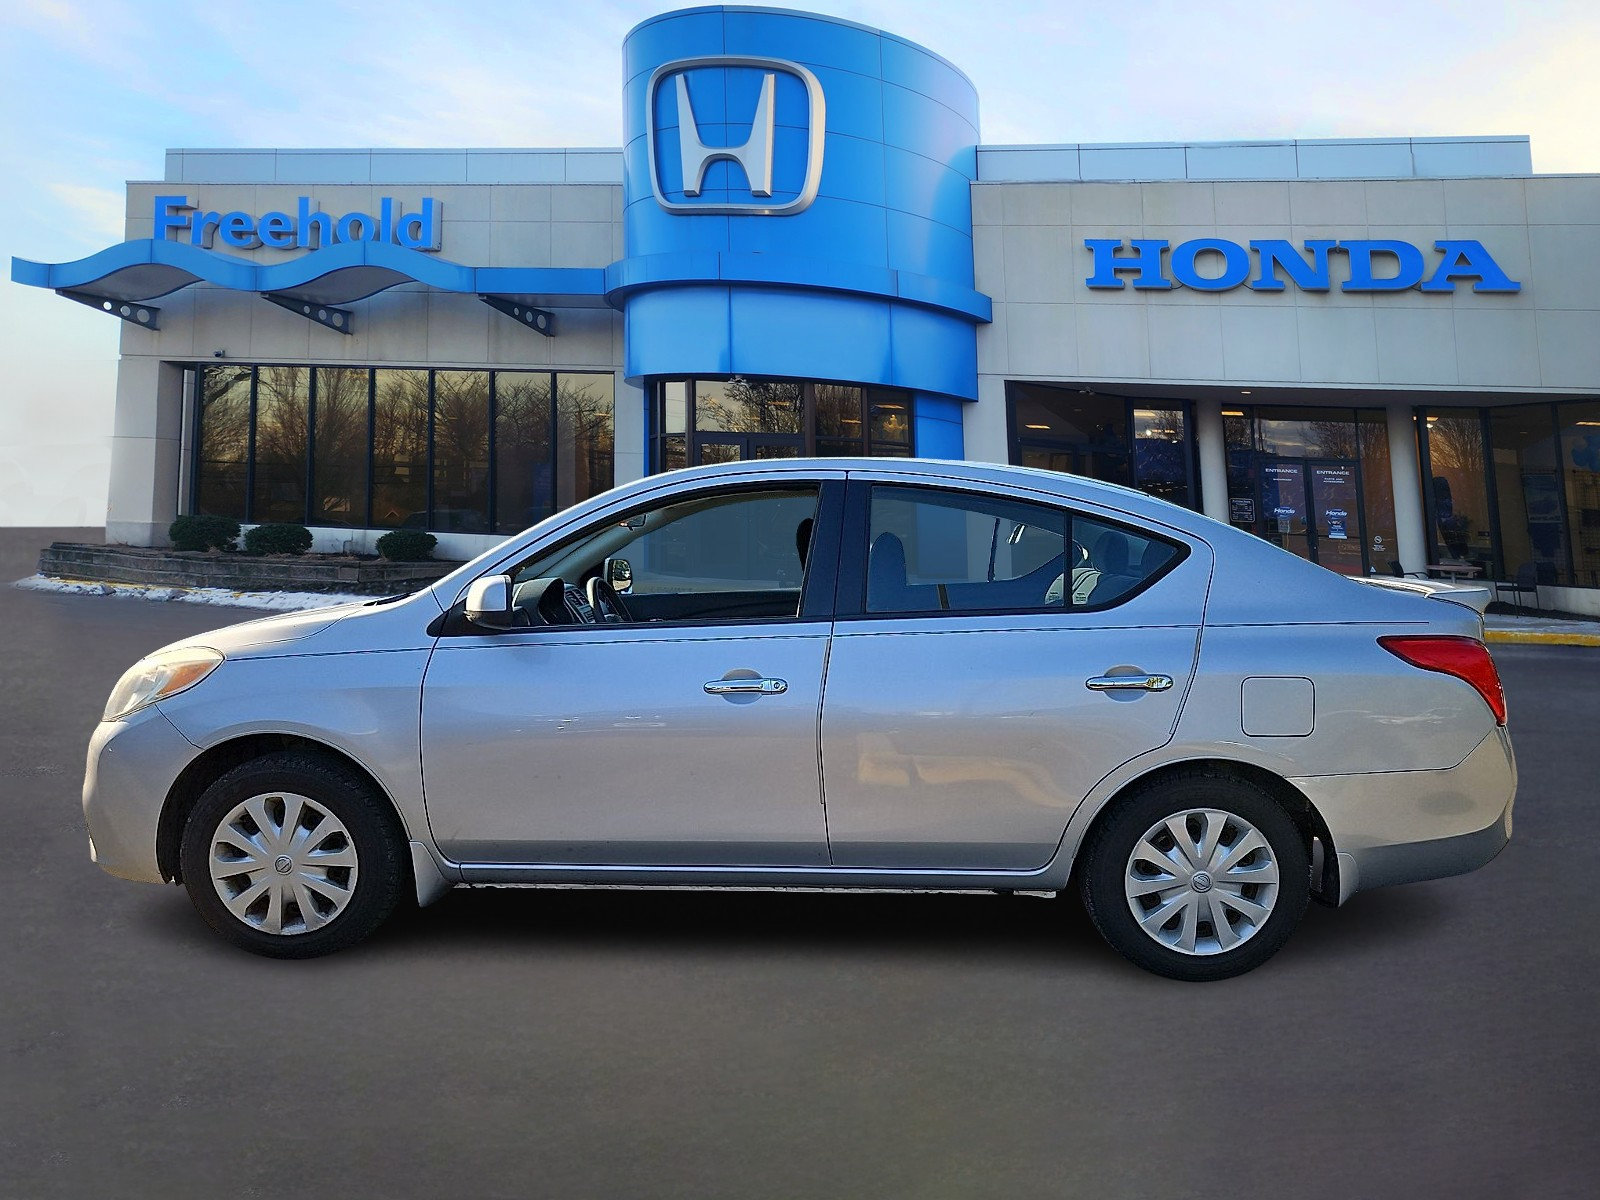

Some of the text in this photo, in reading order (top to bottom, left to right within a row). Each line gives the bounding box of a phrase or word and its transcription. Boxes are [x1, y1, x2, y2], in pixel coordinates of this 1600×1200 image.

[153, 195, 439, 250] Freehold
[1084, 238, 1522, 293] HONDA
[1273, 507, 1296, 515] Honda
